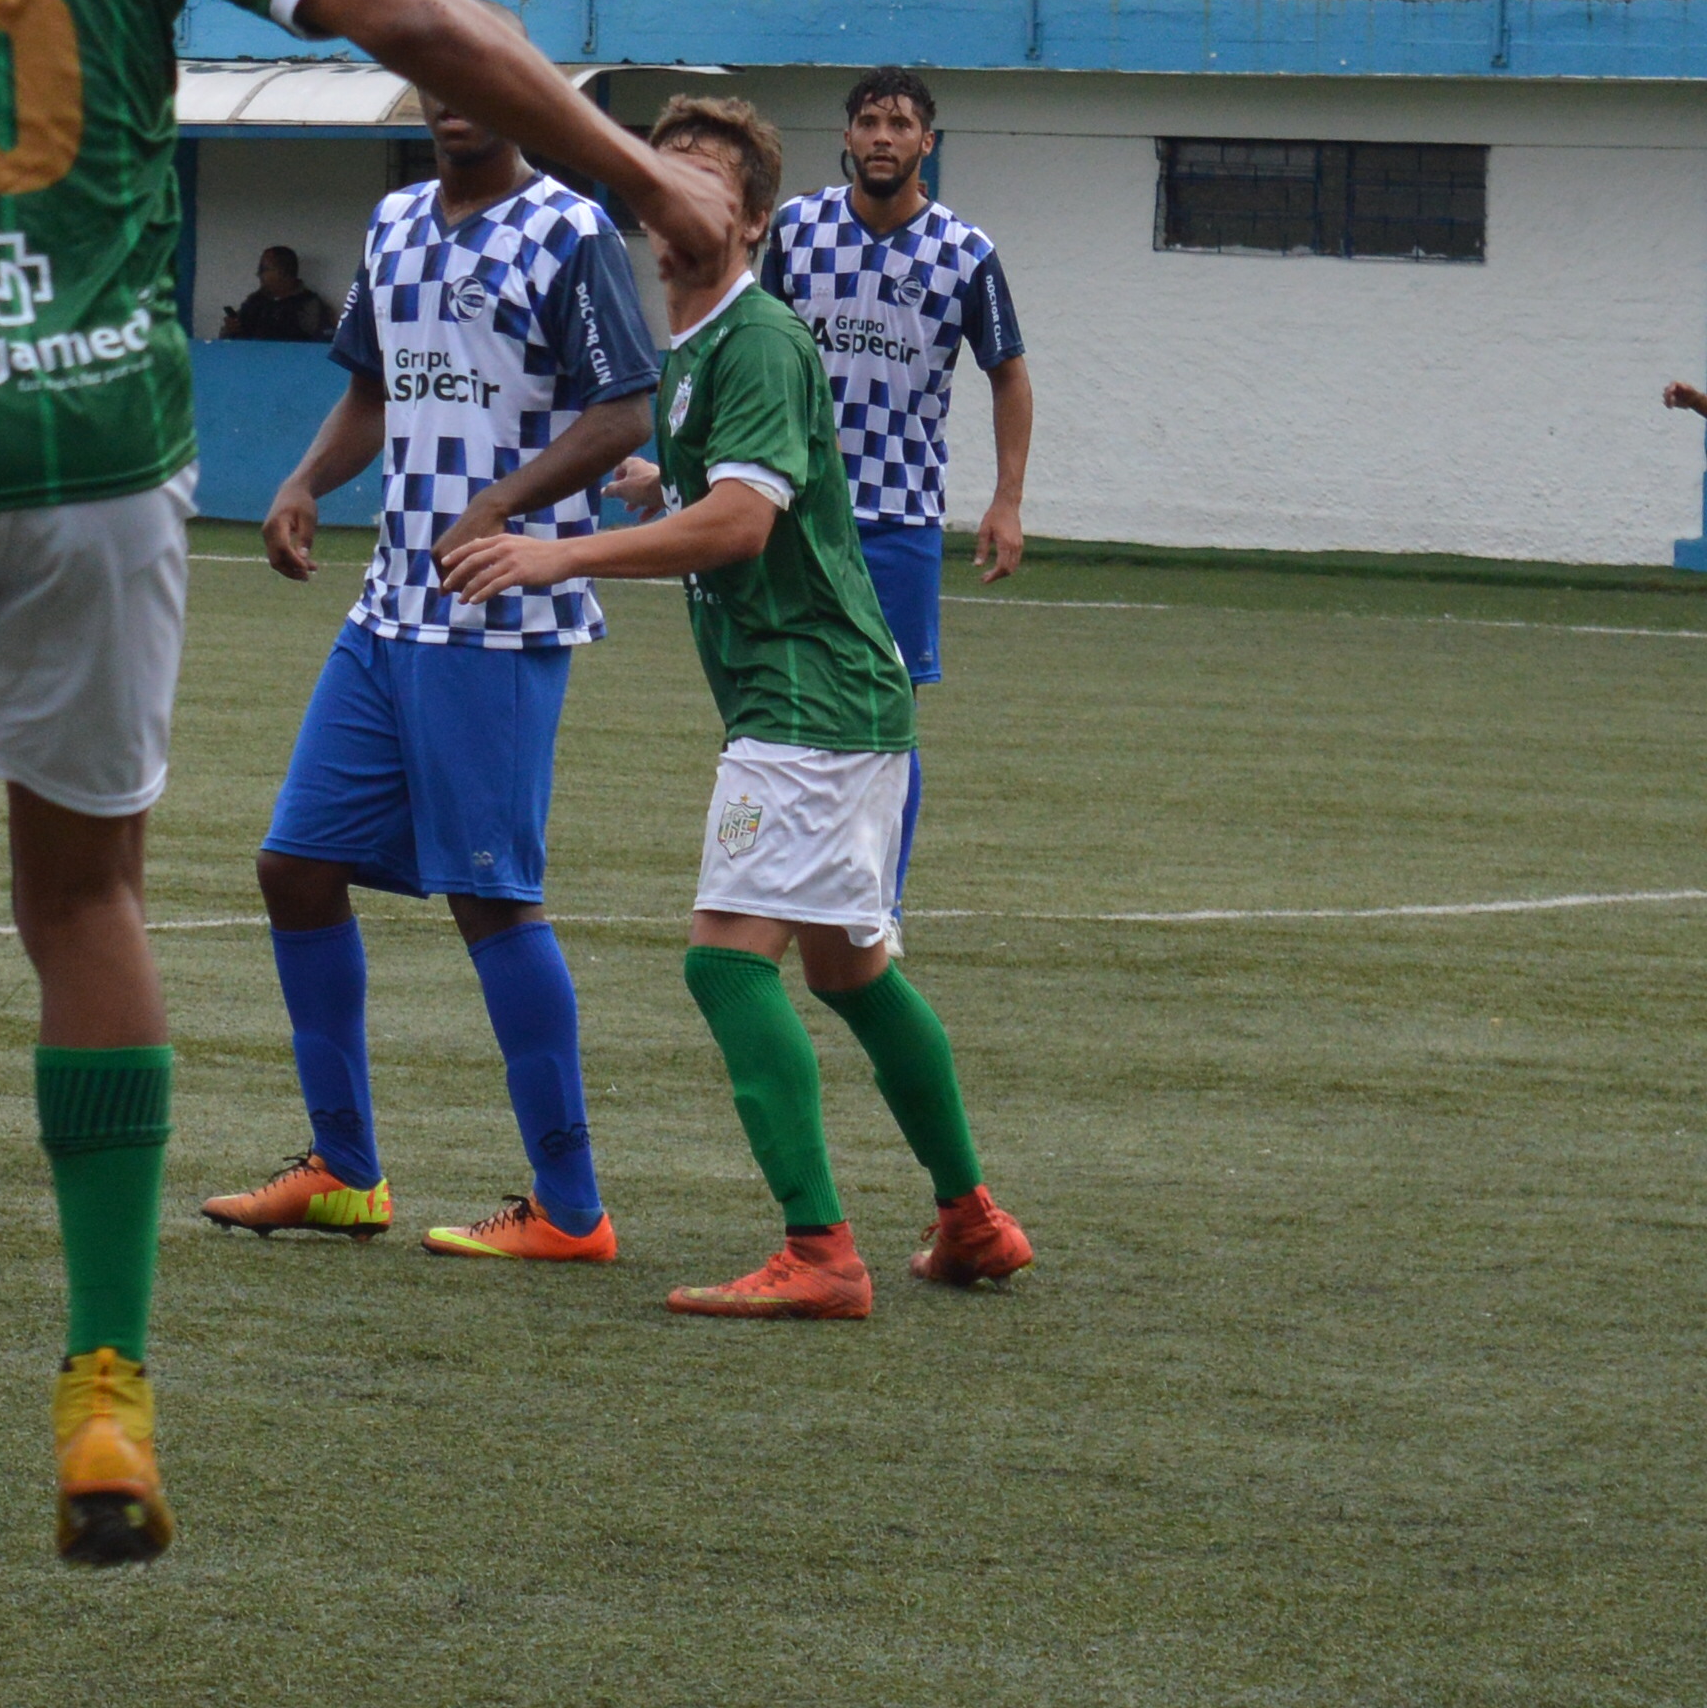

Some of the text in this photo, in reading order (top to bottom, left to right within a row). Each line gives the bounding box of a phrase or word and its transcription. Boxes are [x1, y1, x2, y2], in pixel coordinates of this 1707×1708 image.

[985, 274, 1000, 323] DOCTOR
[812, 317, 921, 366] Aspecir
[835, 315, 885, 334] Grupo
[589, 348, 612, 386] CLIN
[305, 1183, 390, 1225] NIKE
